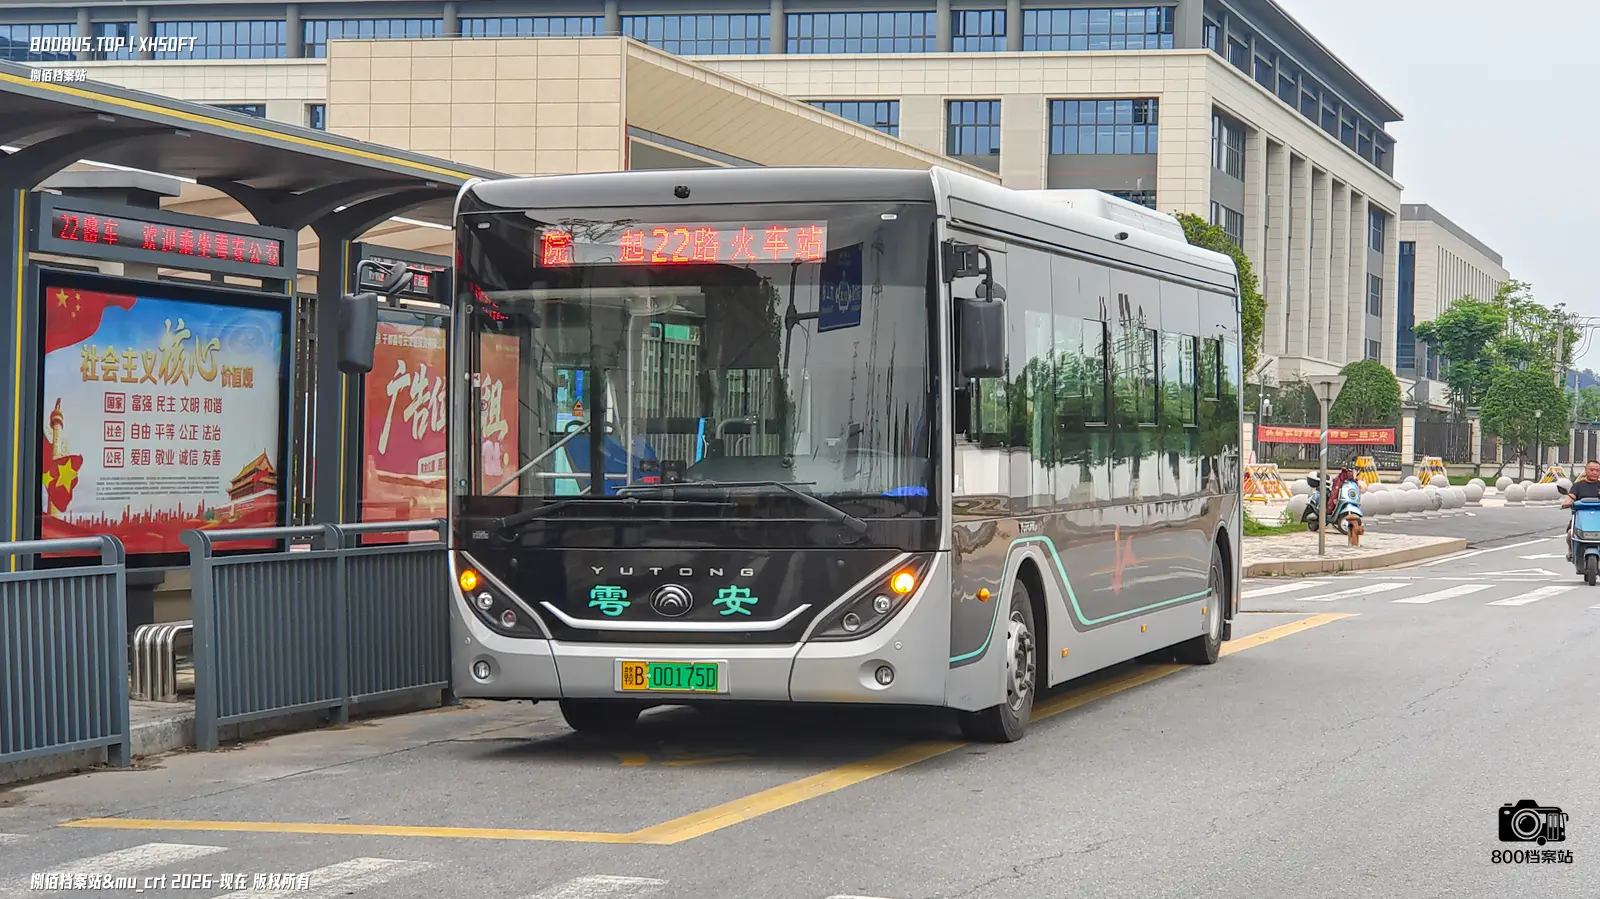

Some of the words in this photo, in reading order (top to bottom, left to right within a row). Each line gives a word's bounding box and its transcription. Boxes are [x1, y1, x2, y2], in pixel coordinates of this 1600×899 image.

[107, 396, 123, 410] 国家
[132, 394, 152, 412] 富强
[156, 396, 176, 412] 民主
[180, 397, 200, 413] 文明
[203, 397, 222, 414] 和谐
[107, 425, 122, 438] 社会
[131, 422, 151, 440] 自由
[155, 423, 175, 440] 平等
[179, 424, 198, 441] 公正
[202, 424, 221, 441] 法治
[106, 451, 121, 464] 公民
[130, 448, 151, 466] 爱国
[155, 448, 175, 466] 敬业
[179, 449, 198, 466] 诚信
[202, 449, 221, 466] 友善
[591, 566, 755, 577] YUTONG
[653, 666, 716, 688] 00175D
